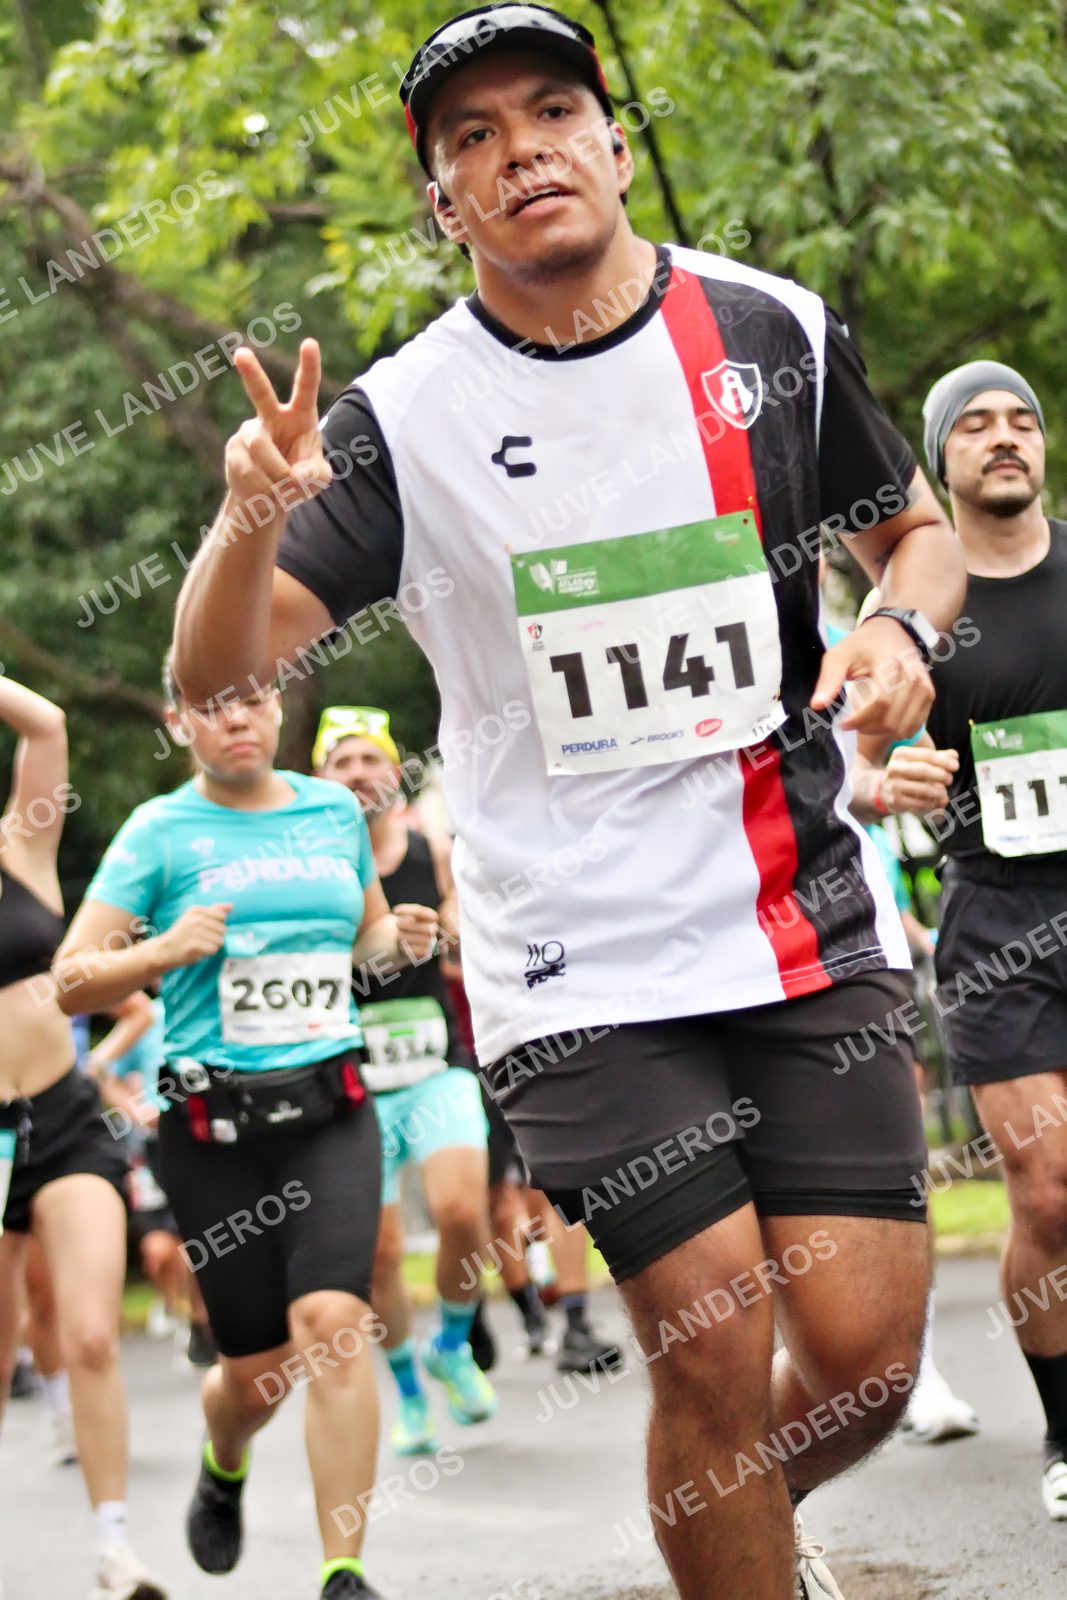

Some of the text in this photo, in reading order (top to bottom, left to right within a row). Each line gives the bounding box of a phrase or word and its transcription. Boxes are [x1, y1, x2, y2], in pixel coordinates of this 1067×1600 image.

[550, 621, 756, 719] 1141
[561, 729, 685, 755] PERDURA BROOKS
[995, 776, 1067, 821] 11
[231, 979, 340, 1012] 2607
